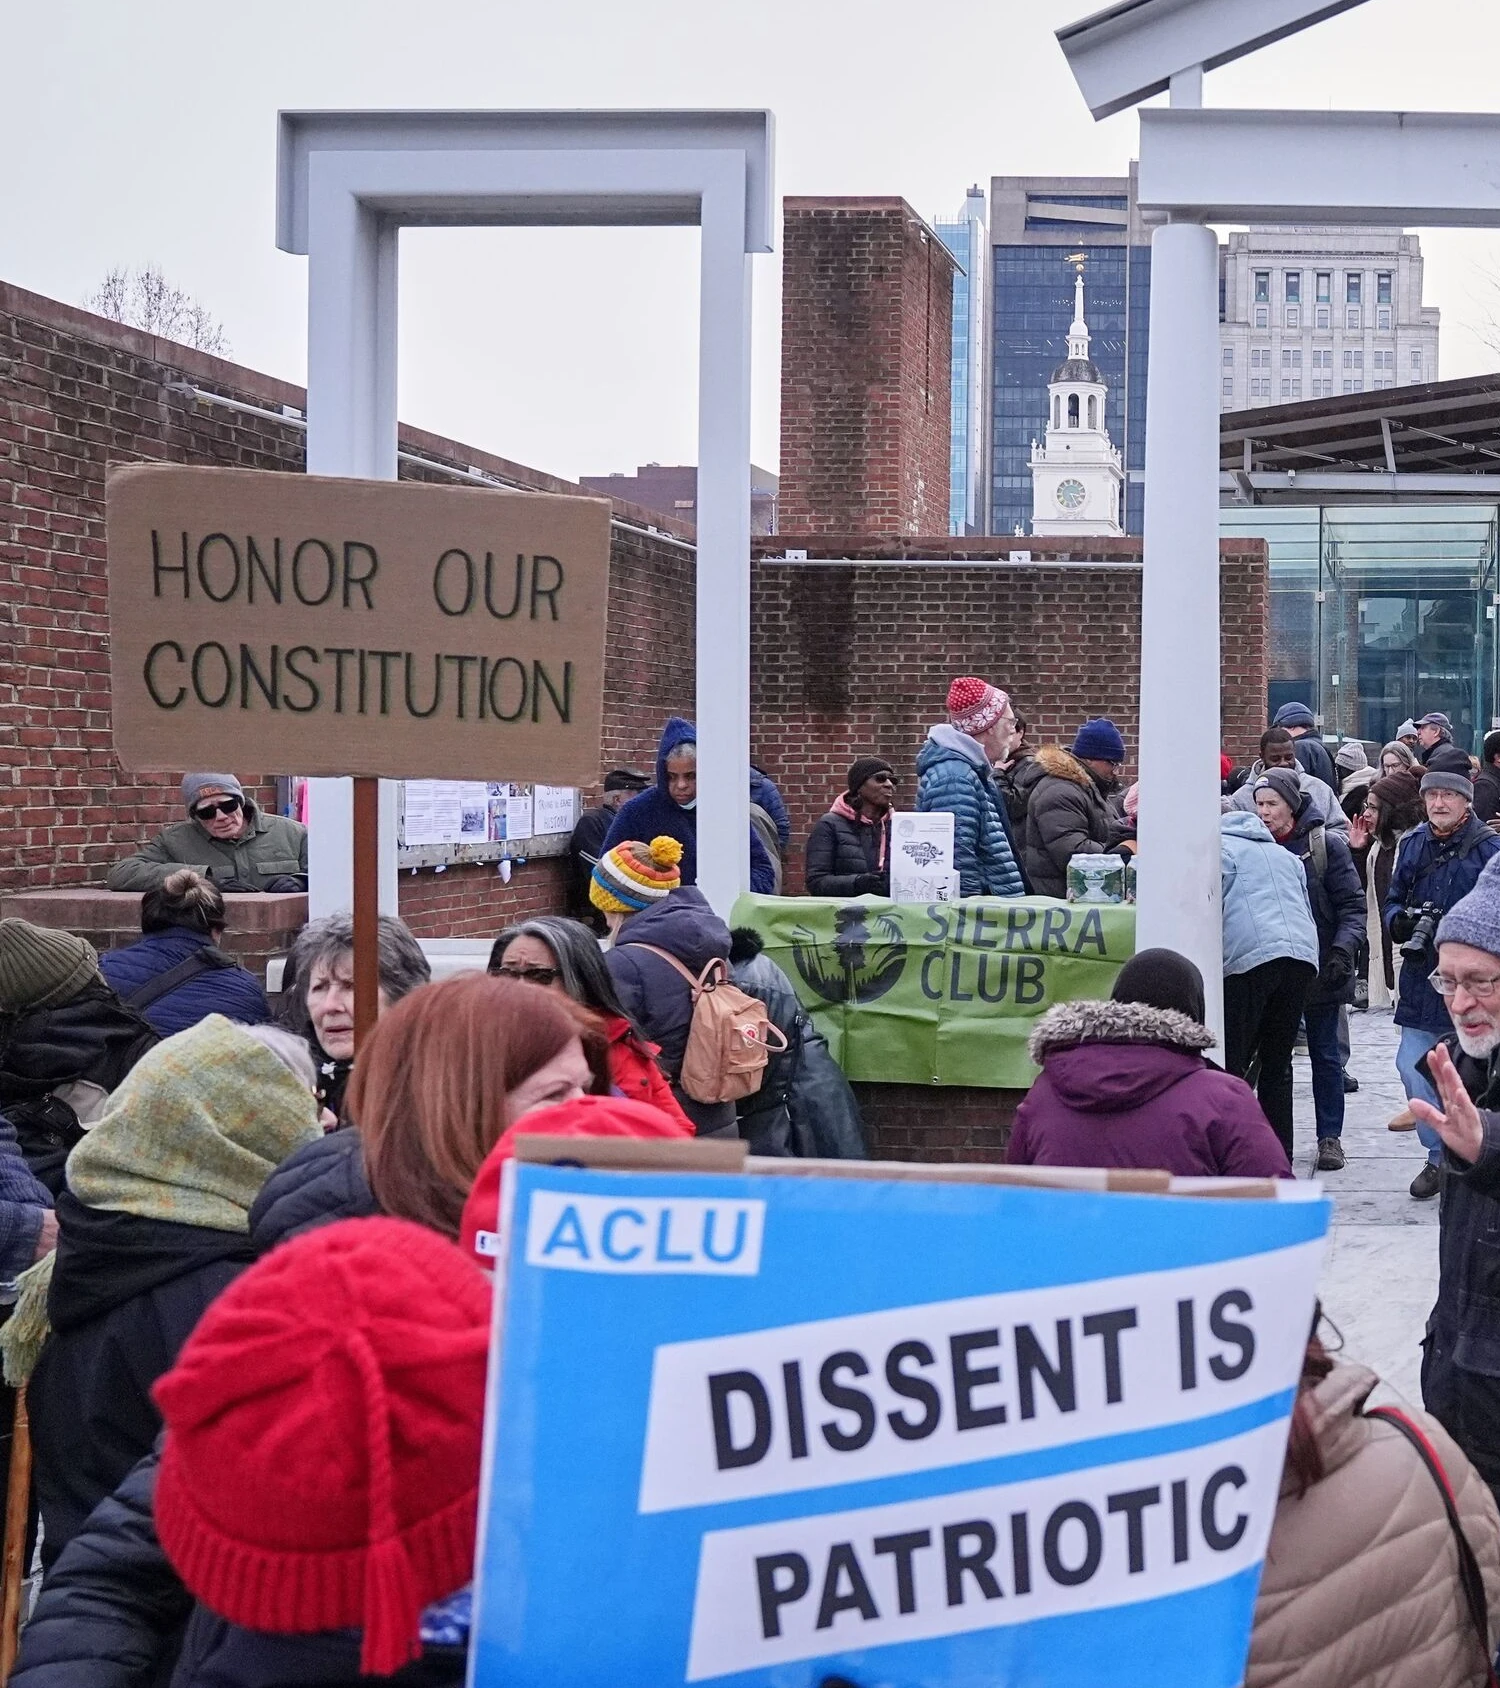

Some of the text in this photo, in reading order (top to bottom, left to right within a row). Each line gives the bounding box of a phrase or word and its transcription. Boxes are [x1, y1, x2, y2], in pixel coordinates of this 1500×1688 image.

[151, 529, 566, 622] HONOR OUR
[143, 640, 573, 724] CONSTITUTION
[922, 904, 1107, 955] SIERRA
[921, 950, 1045, 1004] CLUB
[541, 1204, 749, 1266] ACLU
[707, 1288, 1257, 1471] DISSENT IS
[754, 1464, 1249, 1641] PATRIOTIC
